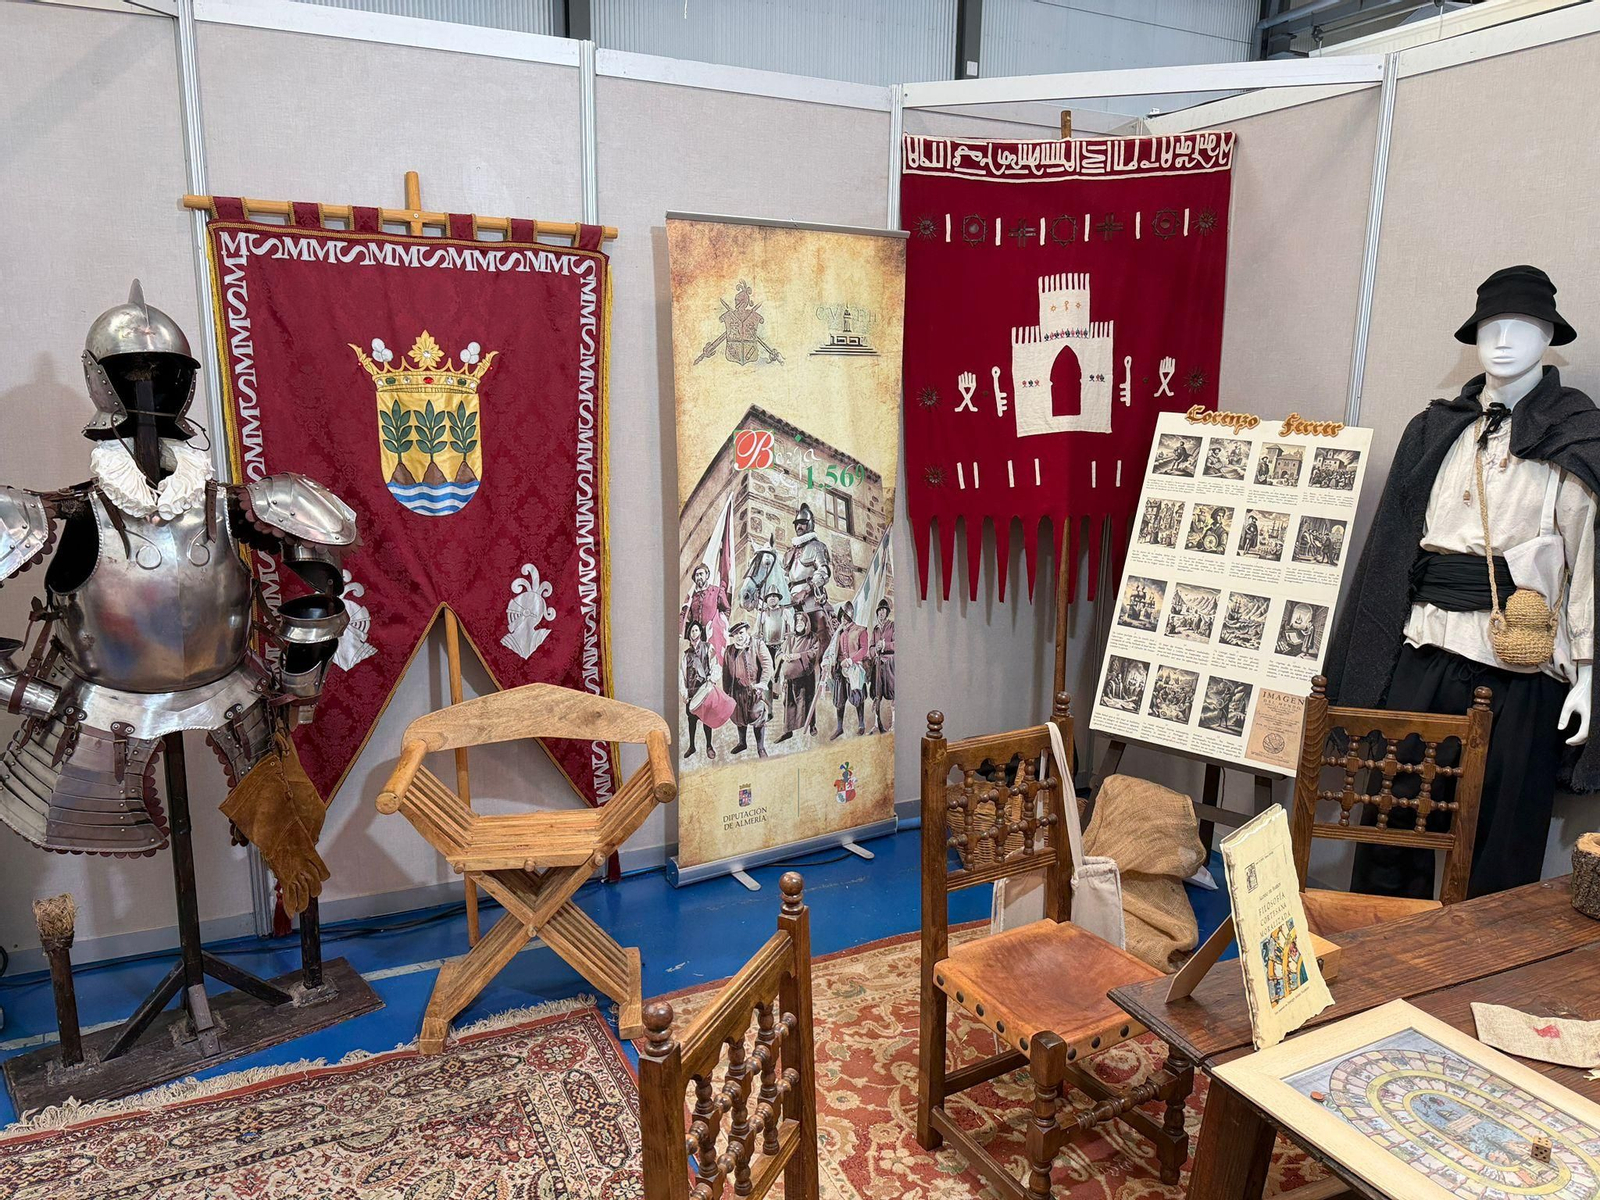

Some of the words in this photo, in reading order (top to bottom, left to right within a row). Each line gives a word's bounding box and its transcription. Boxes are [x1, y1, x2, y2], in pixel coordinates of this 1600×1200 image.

[1279, 412, 1344, 437] Ferrer
[805, 463, 866, 490] 1.569
[1262, 691, 1305, 706] IMAGEN
[723, 822, 734, 831] DE
[734, 814, 767, 829] ALMERÍA
[1258, 891, 1286, 916] FILOSOFÍA
[1260, 902, 1287, 927] CORTESANA
